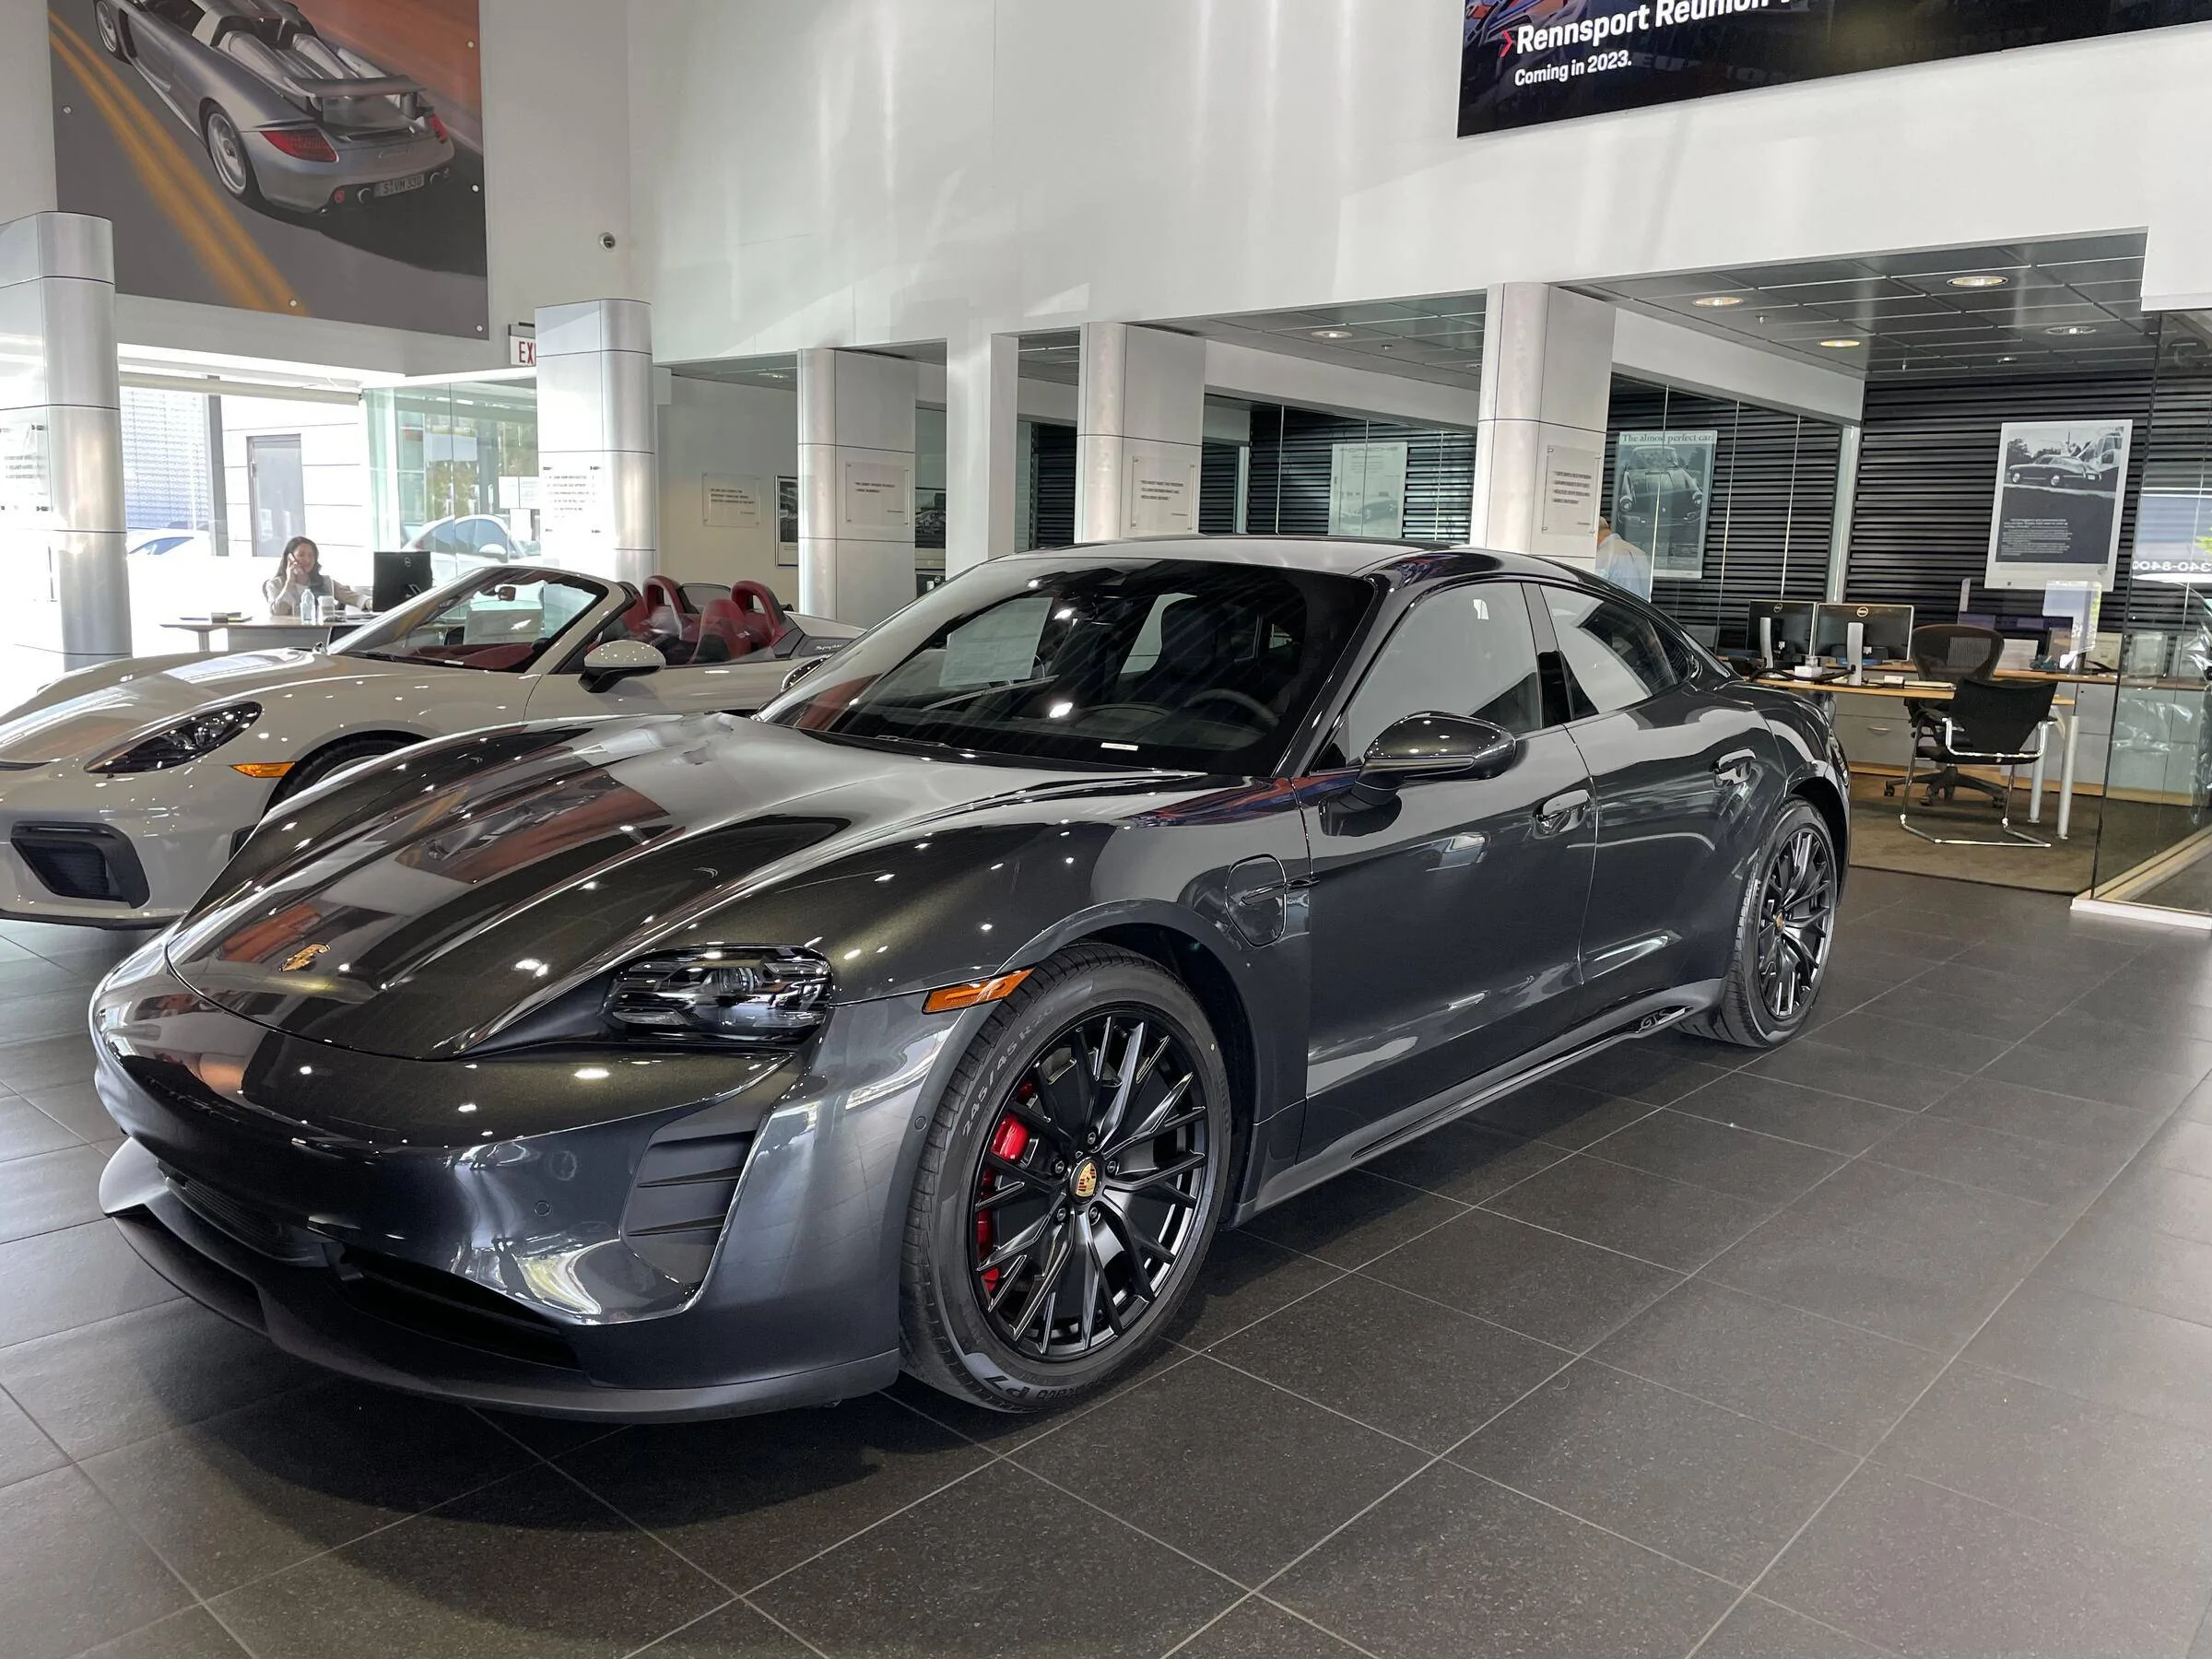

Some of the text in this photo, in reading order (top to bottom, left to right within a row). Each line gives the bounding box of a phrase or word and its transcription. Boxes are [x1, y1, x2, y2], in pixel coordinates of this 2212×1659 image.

[1516, 6, 1649, 53] Rennsport
[1514, 64, 1569, 86] Coming
[1571, 61, 1585, 77] in
[1587, 50, 1632, 72] 2023.
[519, 341, 535, 364] EX
[1623, 434, 1639, 442] The
[1668, 432, 1697, 444] perfect
[1699, 434, 1713, 442] car.
[961, 1041, 1018, 1138] 245/45
